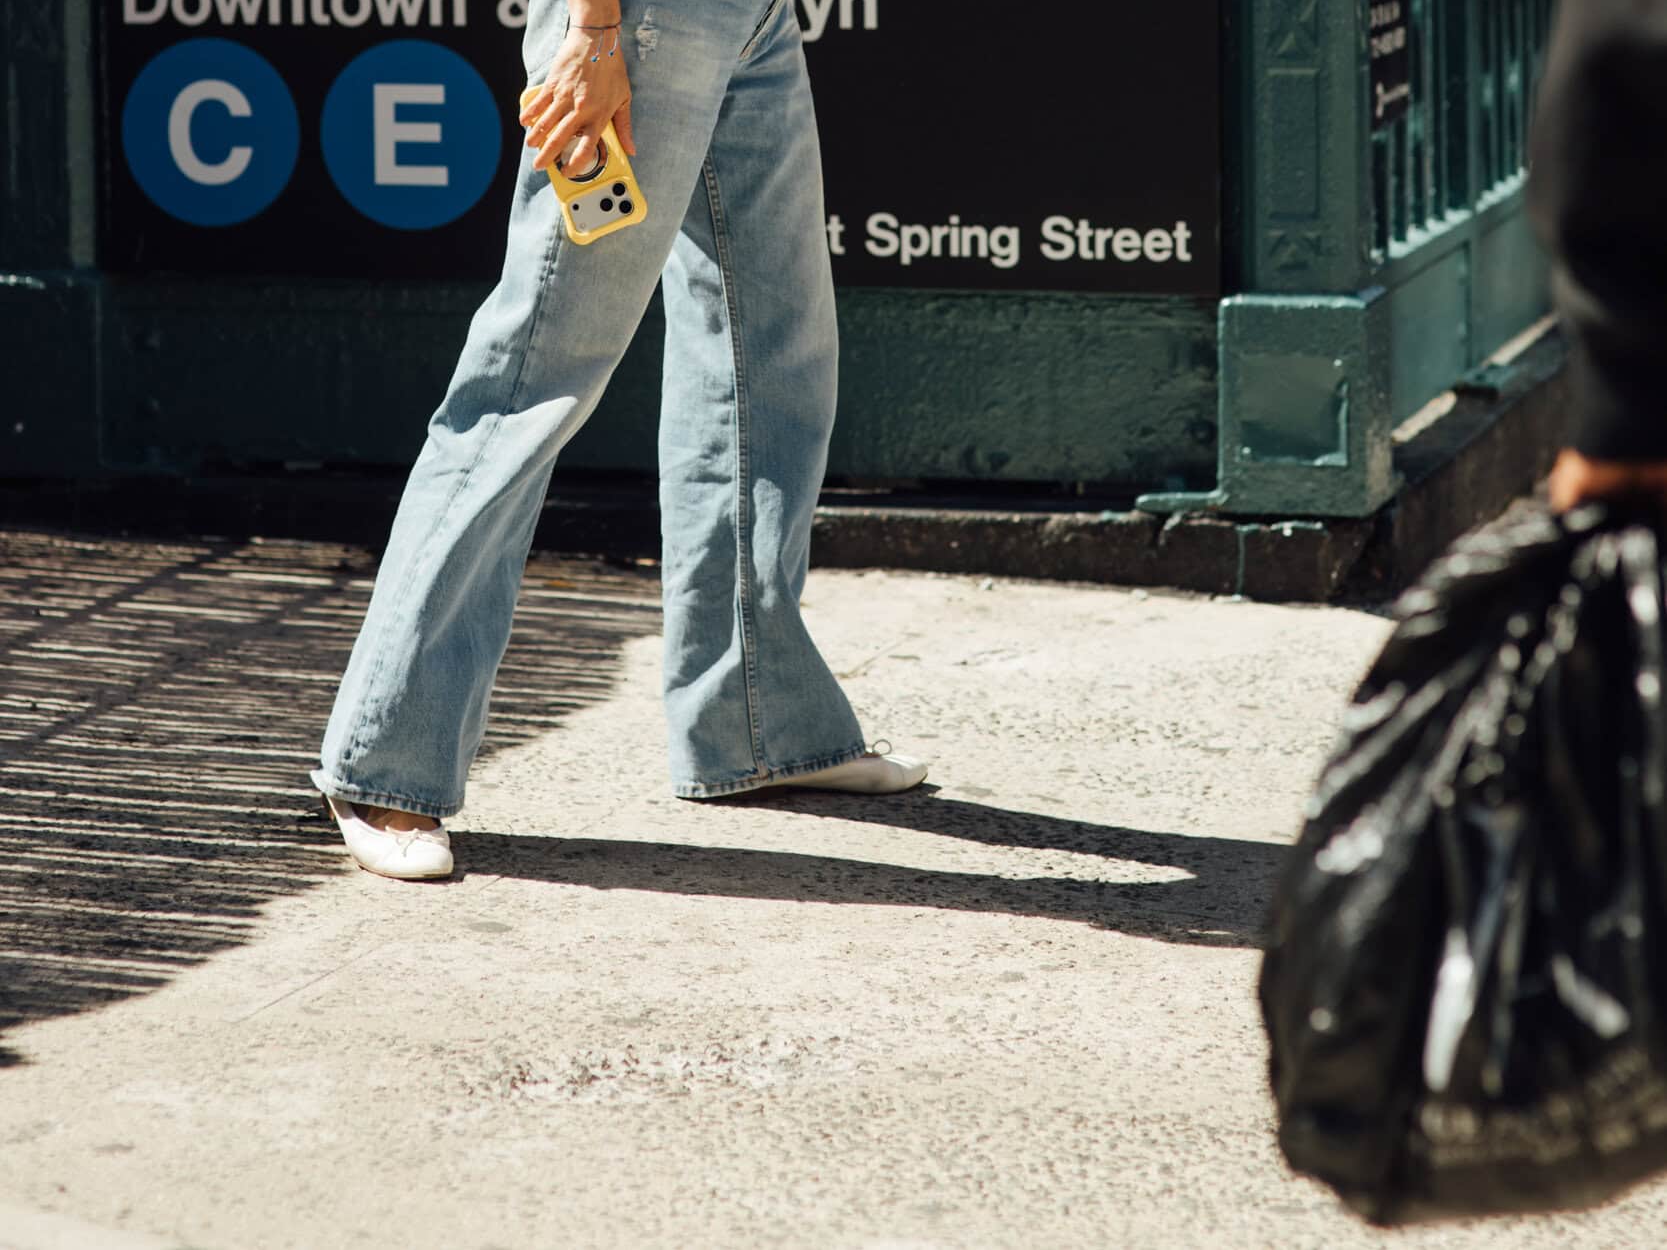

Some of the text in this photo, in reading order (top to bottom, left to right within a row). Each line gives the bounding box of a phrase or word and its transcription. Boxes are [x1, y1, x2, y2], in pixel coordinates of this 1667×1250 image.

[167, 78, 254, 187] C
[372, 82, 449, 188] E
[864, 211, 1021, 269] Spring
[1039, 215, 1193, 263] Street
